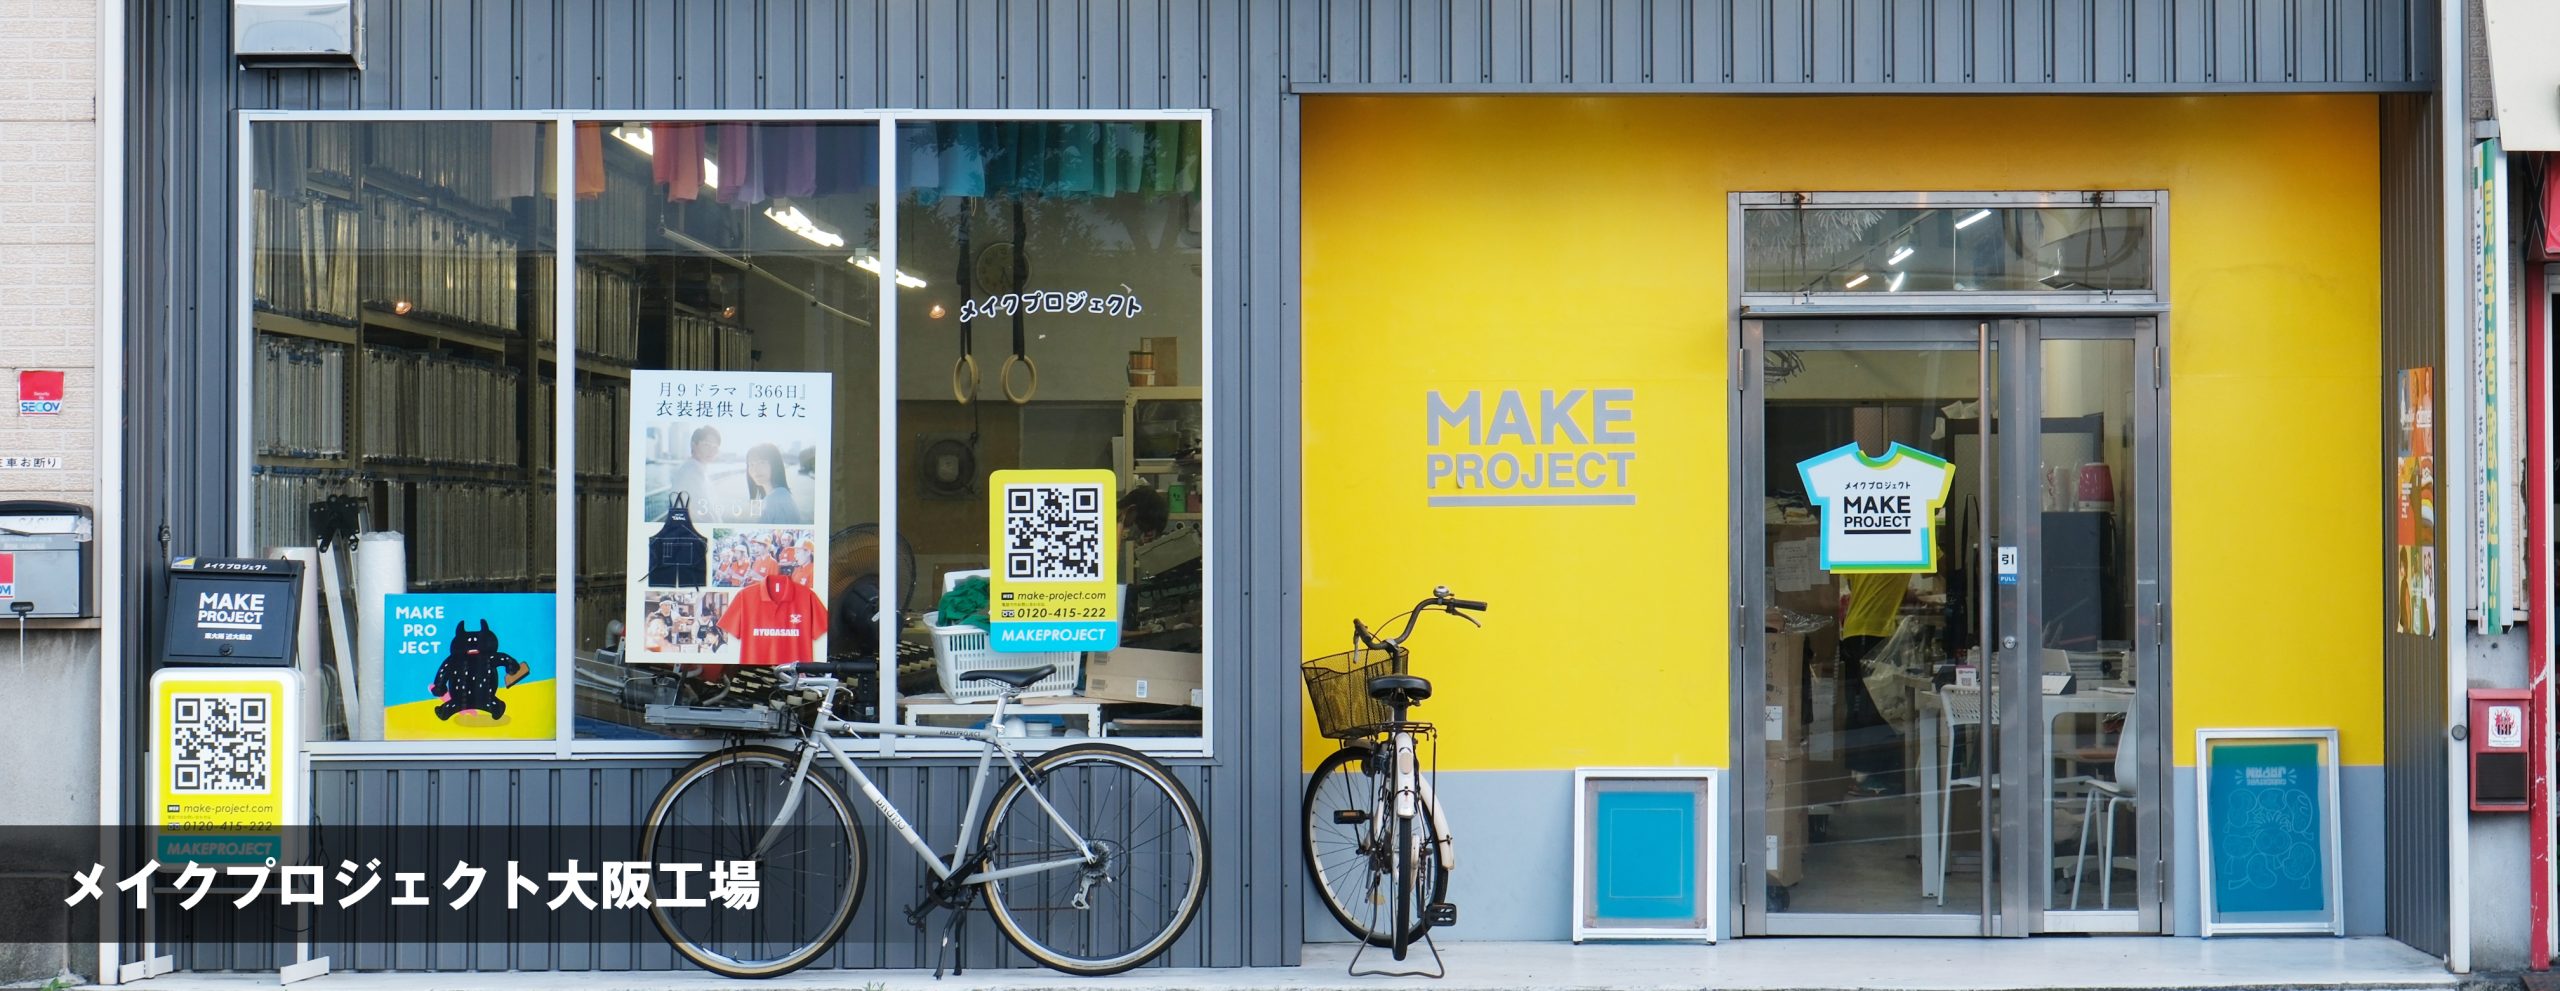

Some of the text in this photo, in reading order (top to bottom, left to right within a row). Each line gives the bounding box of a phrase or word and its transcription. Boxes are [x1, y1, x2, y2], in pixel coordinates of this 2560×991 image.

[960, 290, 1142, 322] メイクプロジェクト
[656, 400, 806, 418] 衣装提供しました
[1427, 389, 1635, 445] MAKE
[0, 457, 56, 468] 車お断り
[1427, 452, 1635, 489] PROJECT
[1845, 481, 1911, 490] メイクプロジェクト
[1844, 496, 1911, 514] MAKE
[1844, 516, 1911, 528] PROJECT
[2002, 554, 2014, 565] 引
[203, 563, 268, 571] メイクプロジェクト
[199, 592, 265, 611] MAKE
[1017, 591, 1106, 602] make-project.com
[198, 610, 264, 623] PROJECT
[395, 606, 445, 619] MAKE
[1017, 608, 1106, 618] 0120-415-222
[403, 624, 437, 637] PRO
[1001, 628, 1106, 641] MAKEPROJECT
[399, 641, 442, 655] JECT
[184, 805, 273, 814] make-project.com
[183, 821, 272, 831] 0120-415-222
[167, 842, 273, 856] MAKEPROJECT
